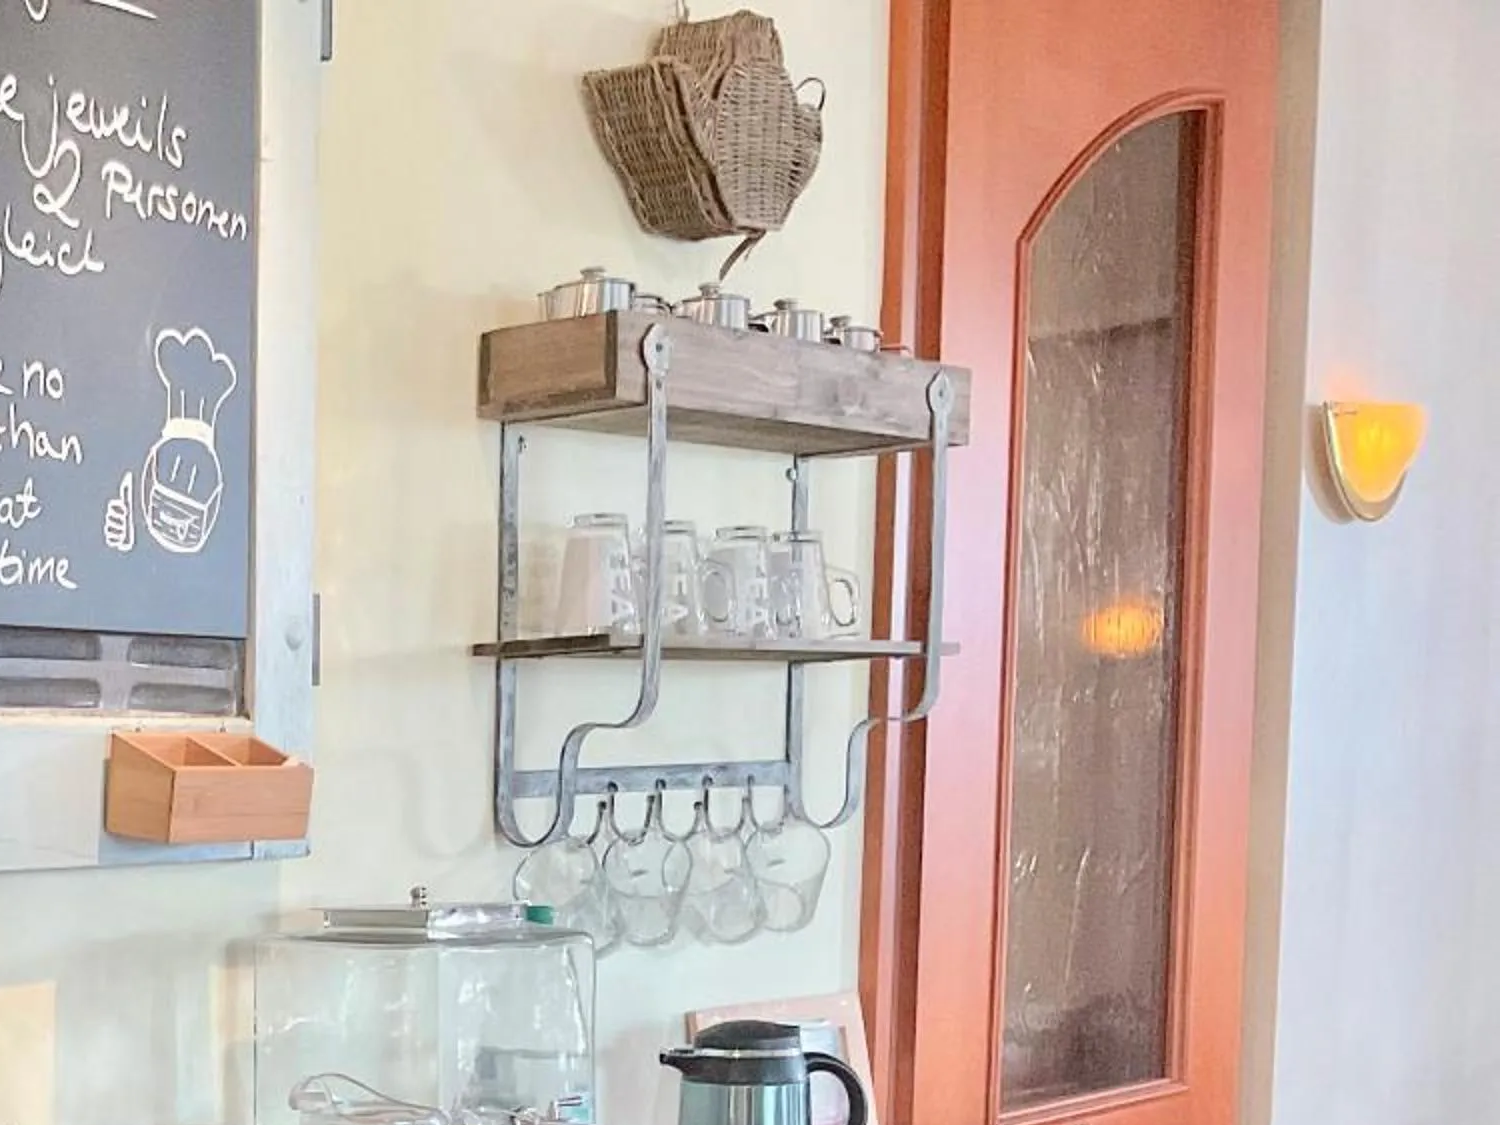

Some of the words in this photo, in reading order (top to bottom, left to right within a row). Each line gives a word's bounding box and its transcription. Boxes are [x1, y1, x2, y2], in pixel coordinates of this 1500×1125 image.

[21, 73, 188, 179] jeweils
[32, 139, 82, 229] 2
[101, 160, 248, 242] Personen
[22, 357, 65, 400] no
